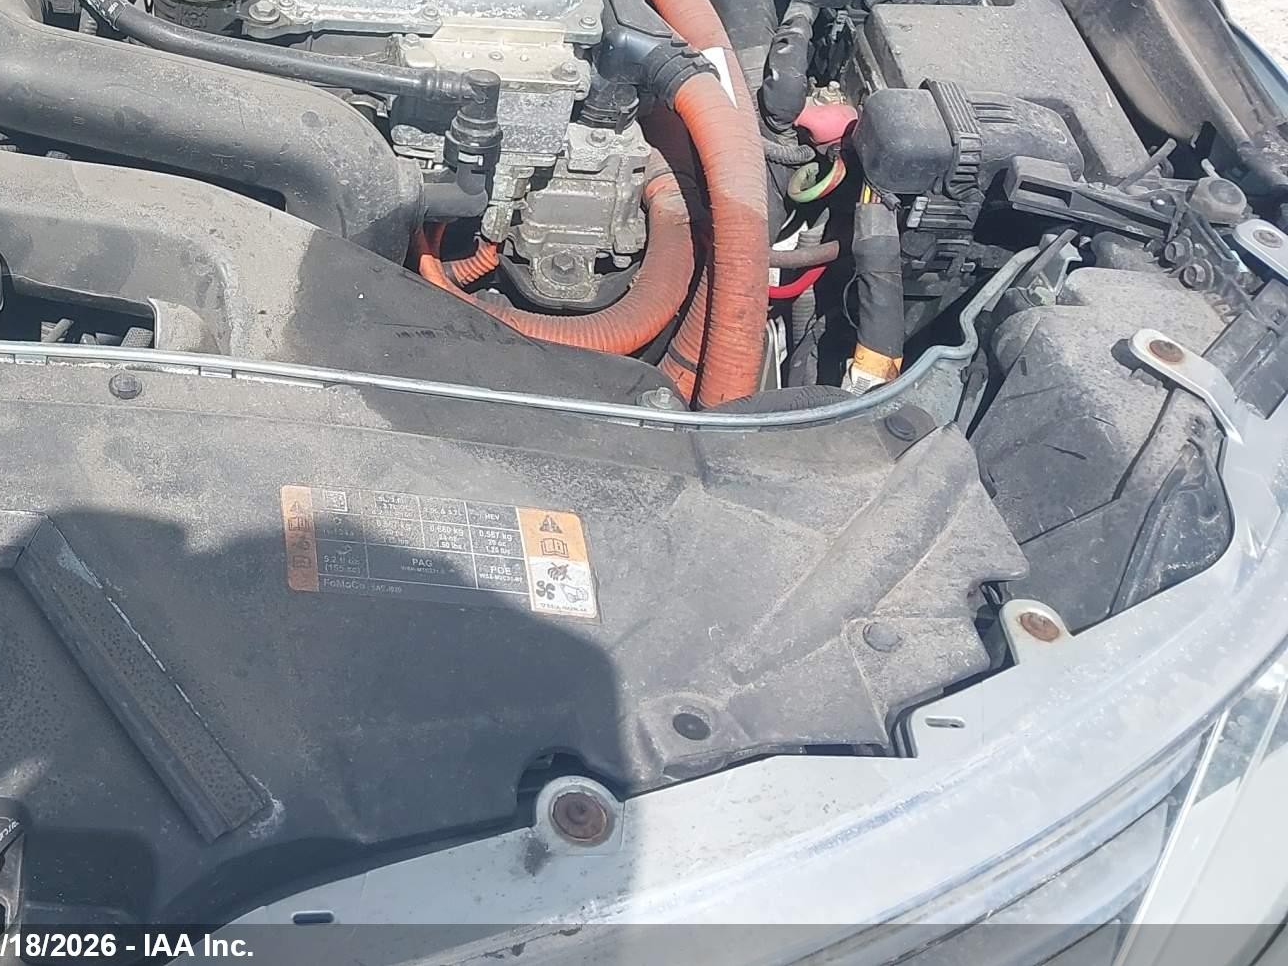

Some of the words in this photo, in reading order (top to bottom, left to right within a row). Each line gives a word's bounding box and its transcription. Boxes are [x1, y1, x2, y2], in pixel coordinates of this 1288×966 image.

[412, 558, 433, 567] PAG
[490, 565, 512, 575] POE
[323, 578, 366, 590] FoMoCo
